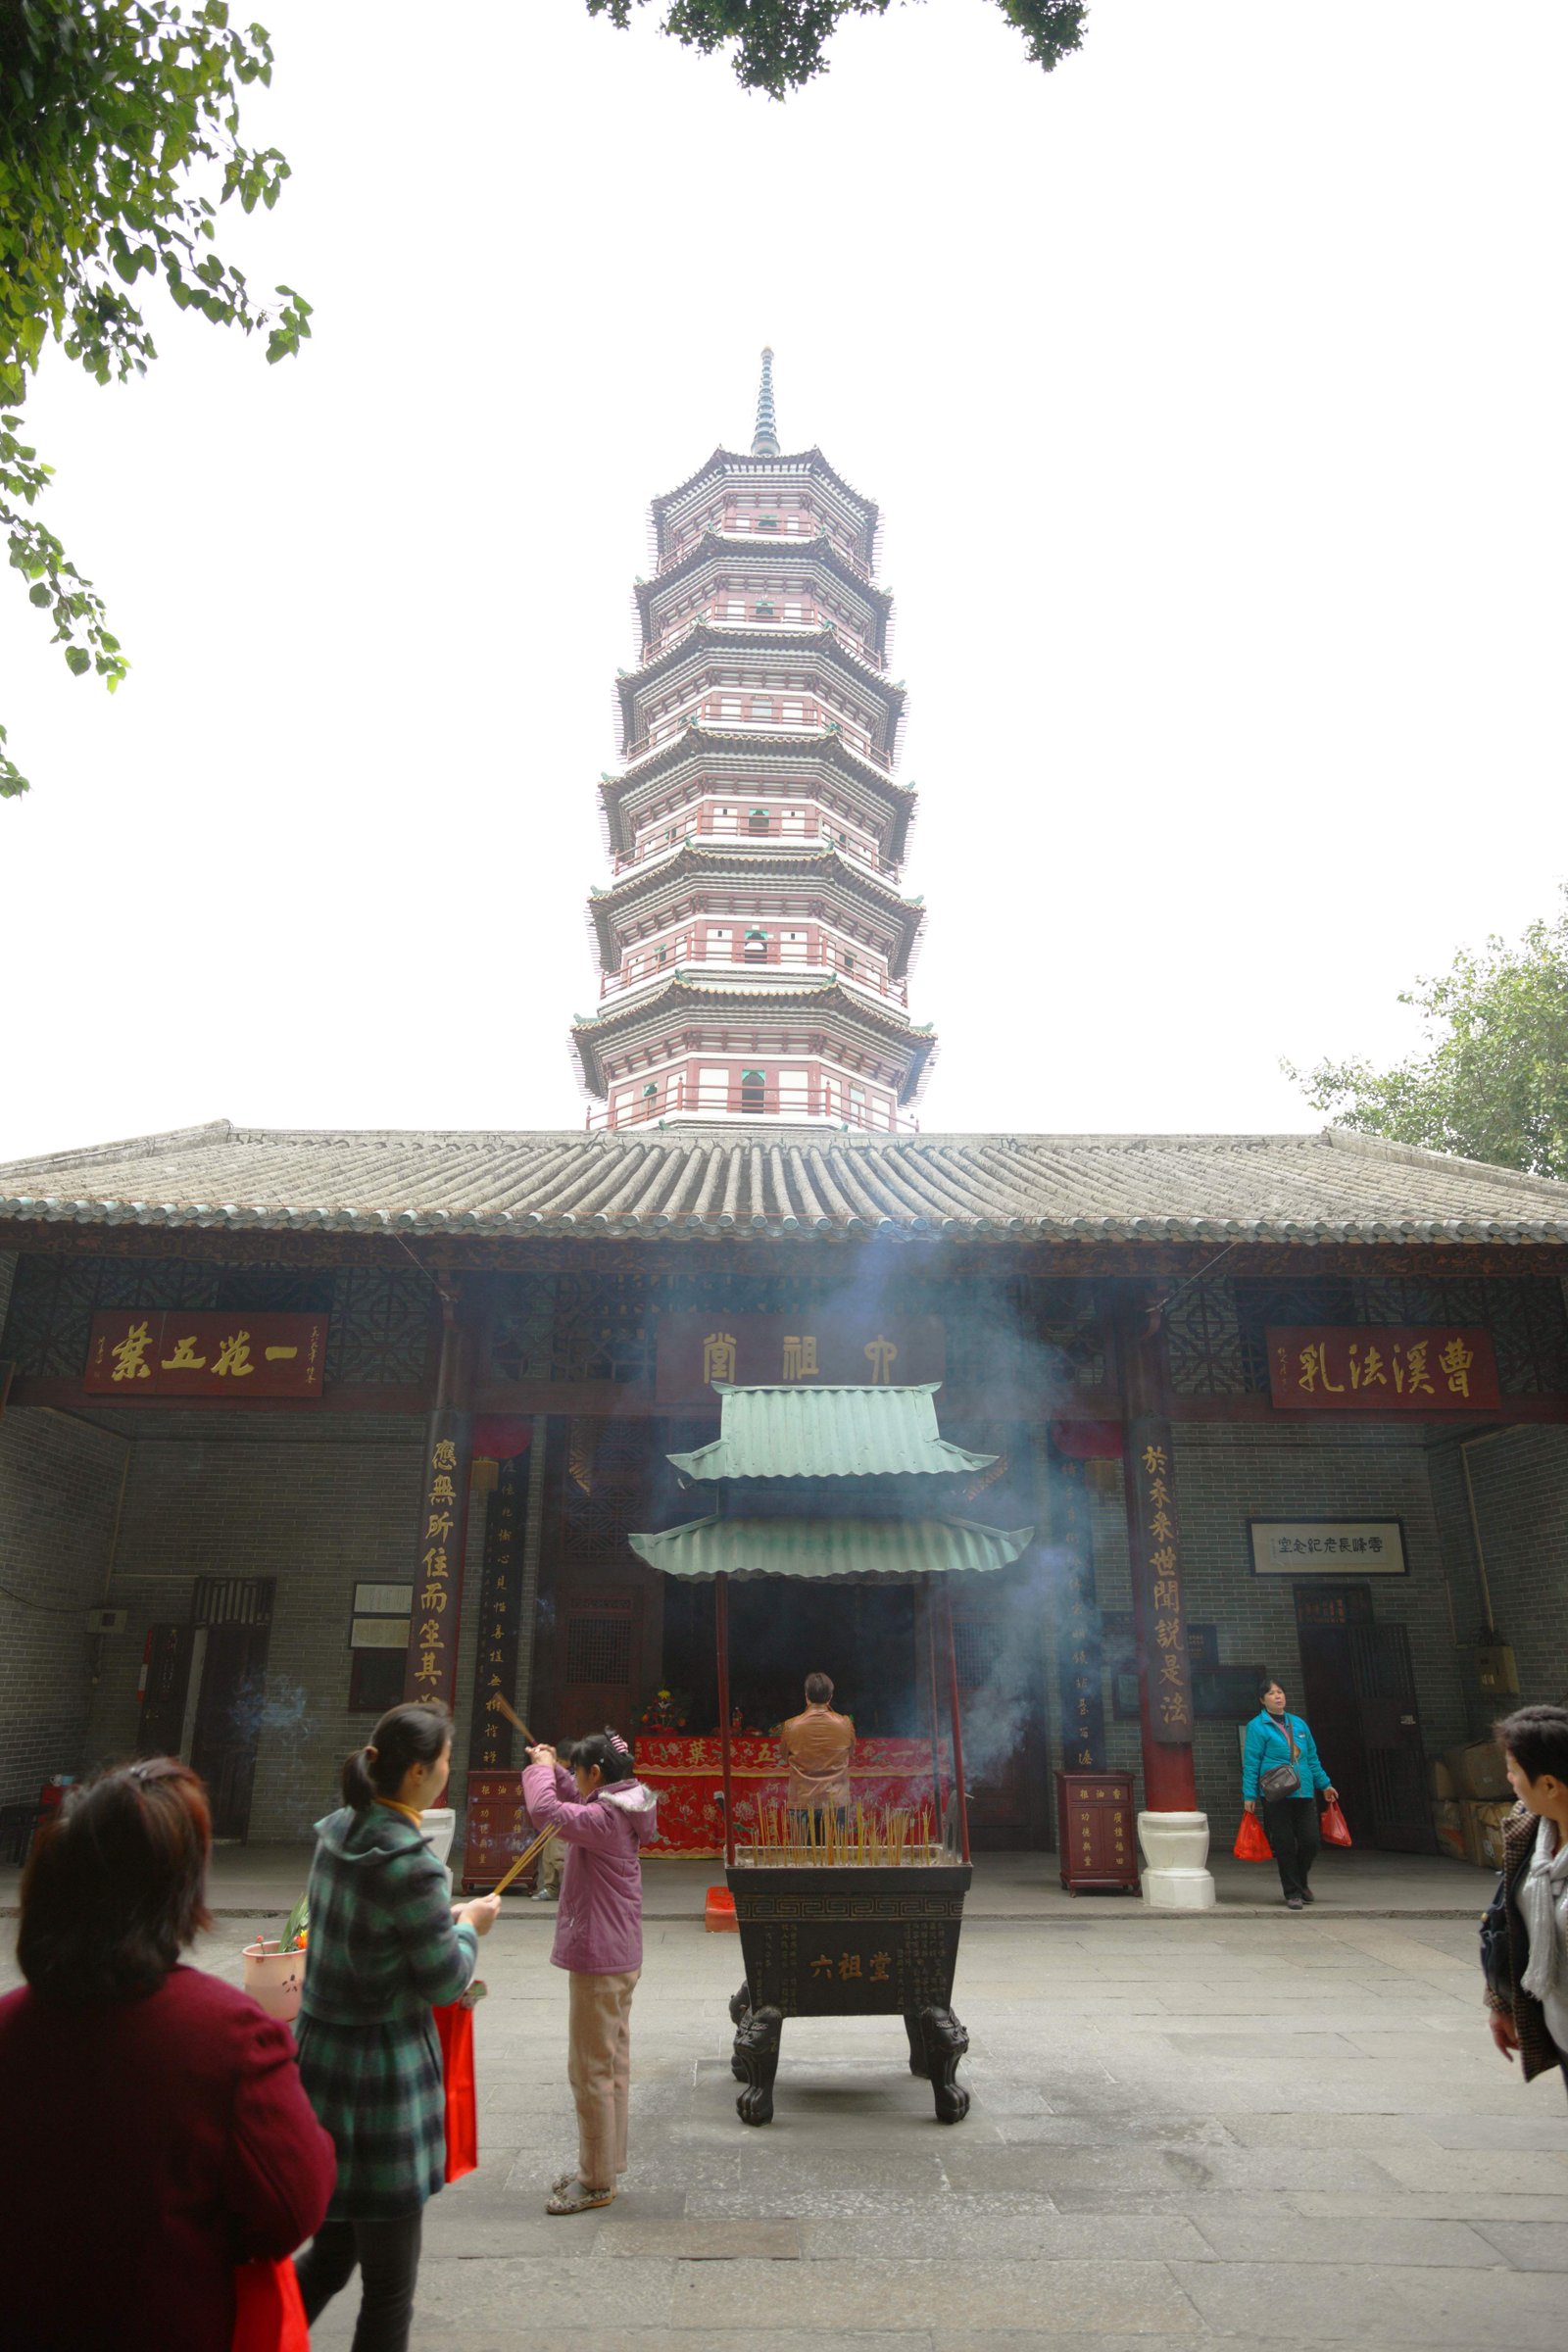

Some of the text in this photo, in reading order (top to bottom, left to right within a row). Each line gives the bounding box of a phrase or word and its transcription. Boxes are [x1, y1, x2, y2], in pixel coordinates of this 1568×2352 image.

[703, 1331, 899, 1385] 六祖堂
[809, 1950, 893, 1983] 六祖堂
